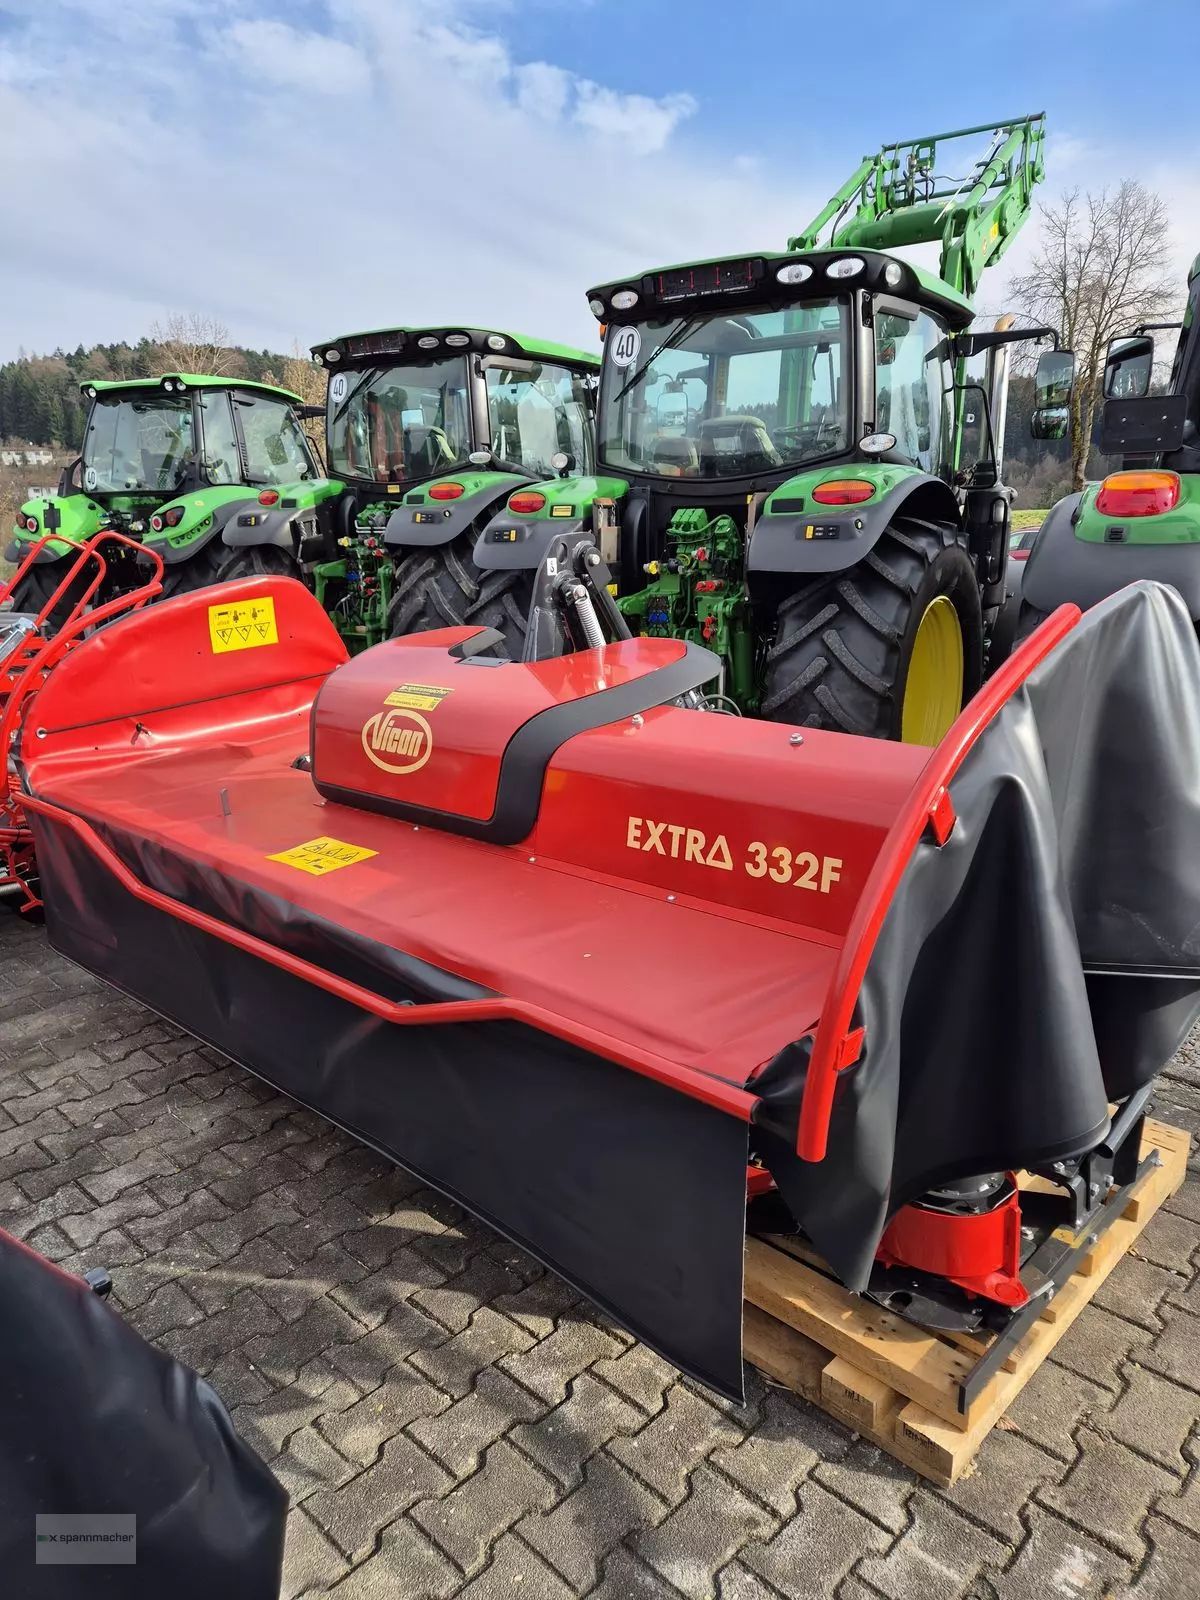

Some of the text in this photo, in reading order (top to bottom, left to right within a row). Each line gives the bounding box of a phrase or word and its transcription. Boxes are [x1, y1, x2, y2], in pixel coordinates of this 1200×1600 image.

[616, 333, 635, 359] 40
[333, 378, 344, 397] 40
[371, 711, 424, 757] Vicon
[626, 816, 843, 893] EXTRA 332F
